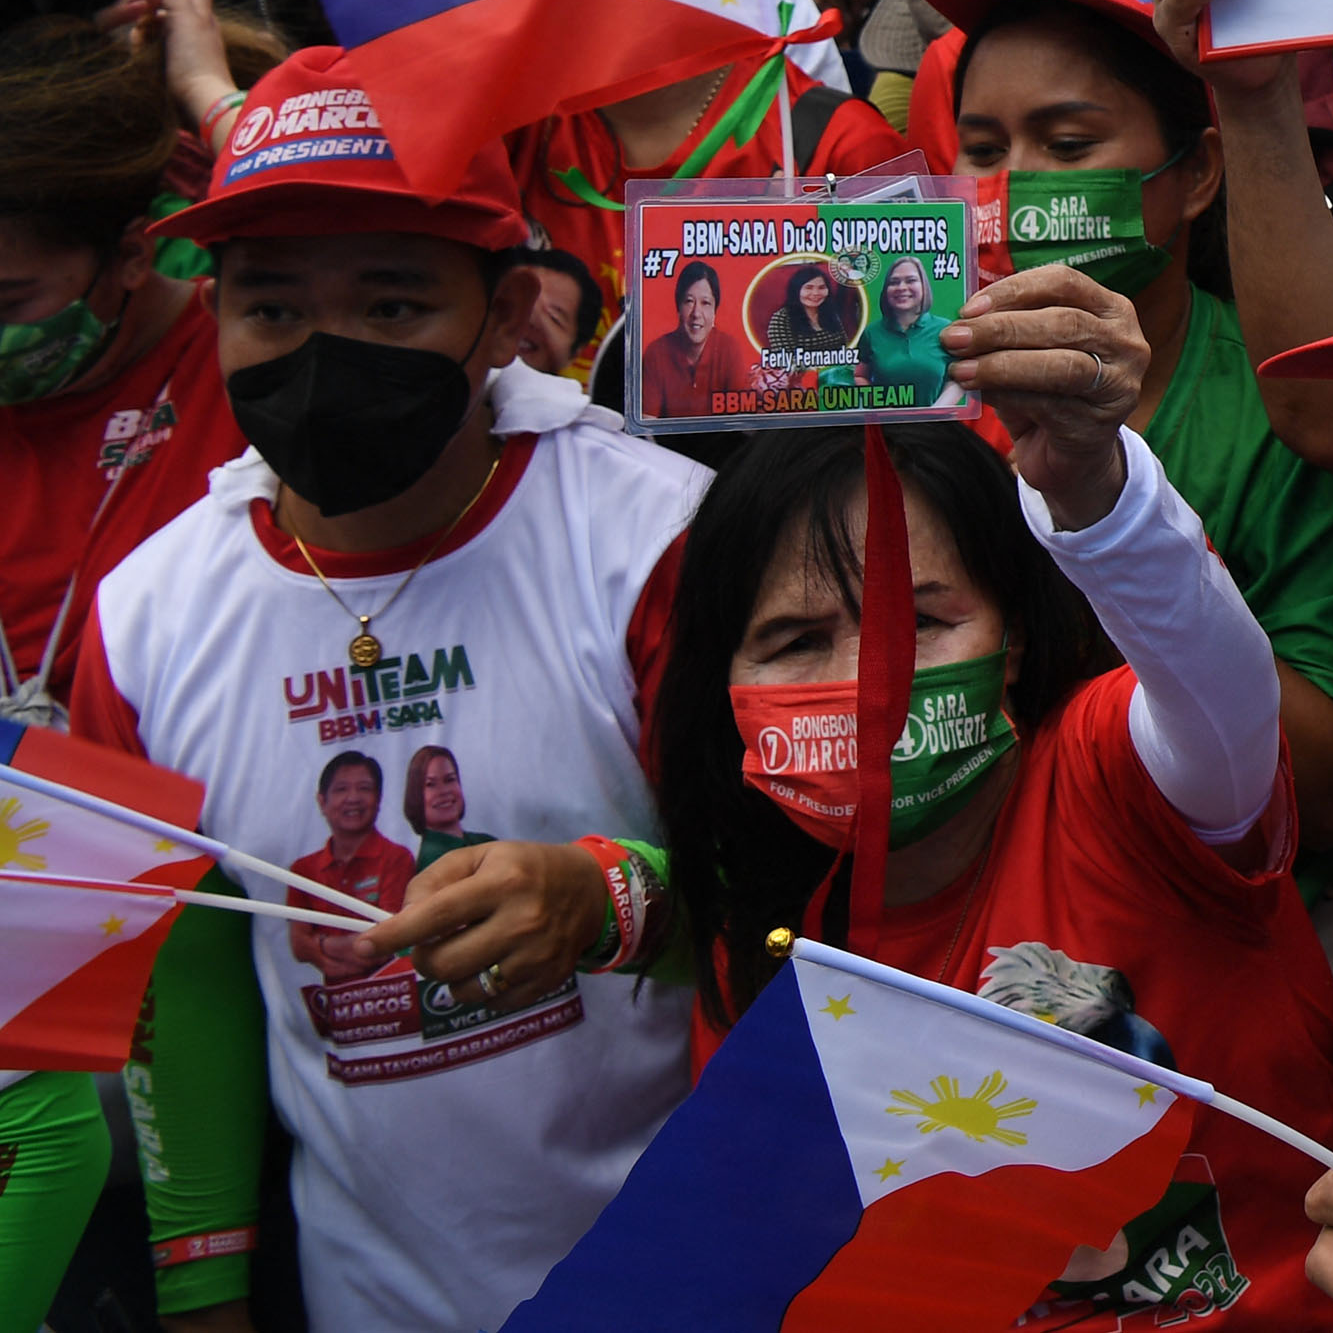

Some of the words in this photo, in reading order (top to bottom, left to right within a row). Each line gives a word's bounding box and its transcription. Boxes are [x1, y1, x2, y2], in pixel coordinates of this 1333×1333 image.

[278, 89, 373, 116] BONGB
[1050, 195, 1089, 218] SARA
[682, 220, 778, 256] BBM-SARA
[783, 222, 826, 254] Du30
[831, 218, 948, 252] SUPPORTERS
[1049, 215, 1112, 242] DUTERTE
[643, 249, 679, 277] #7
[933, 253, 960, 279] #4
[761, 348, 793, 371] Ferly
[796, 347, 860, 367] Fernandez
[712, 389, 818, 414] BBM-SARA
[823, 385, 915, 409] UNITEAM
[924, 692, 967, 722] SARA
[792, 714, 858, 741] BONGBON
[926, 712, 988, 755] DUTERTE
[792, 737, 858, 773] MARCO
[769, 781, 795, 801] FOR
[798, 792, 857, 817] PRESIDE
[918, 784, 945, 803] VICE
[334, 993, 413, 1021] MARCOS
[1093, 1224, 1211, 1304] ARA
